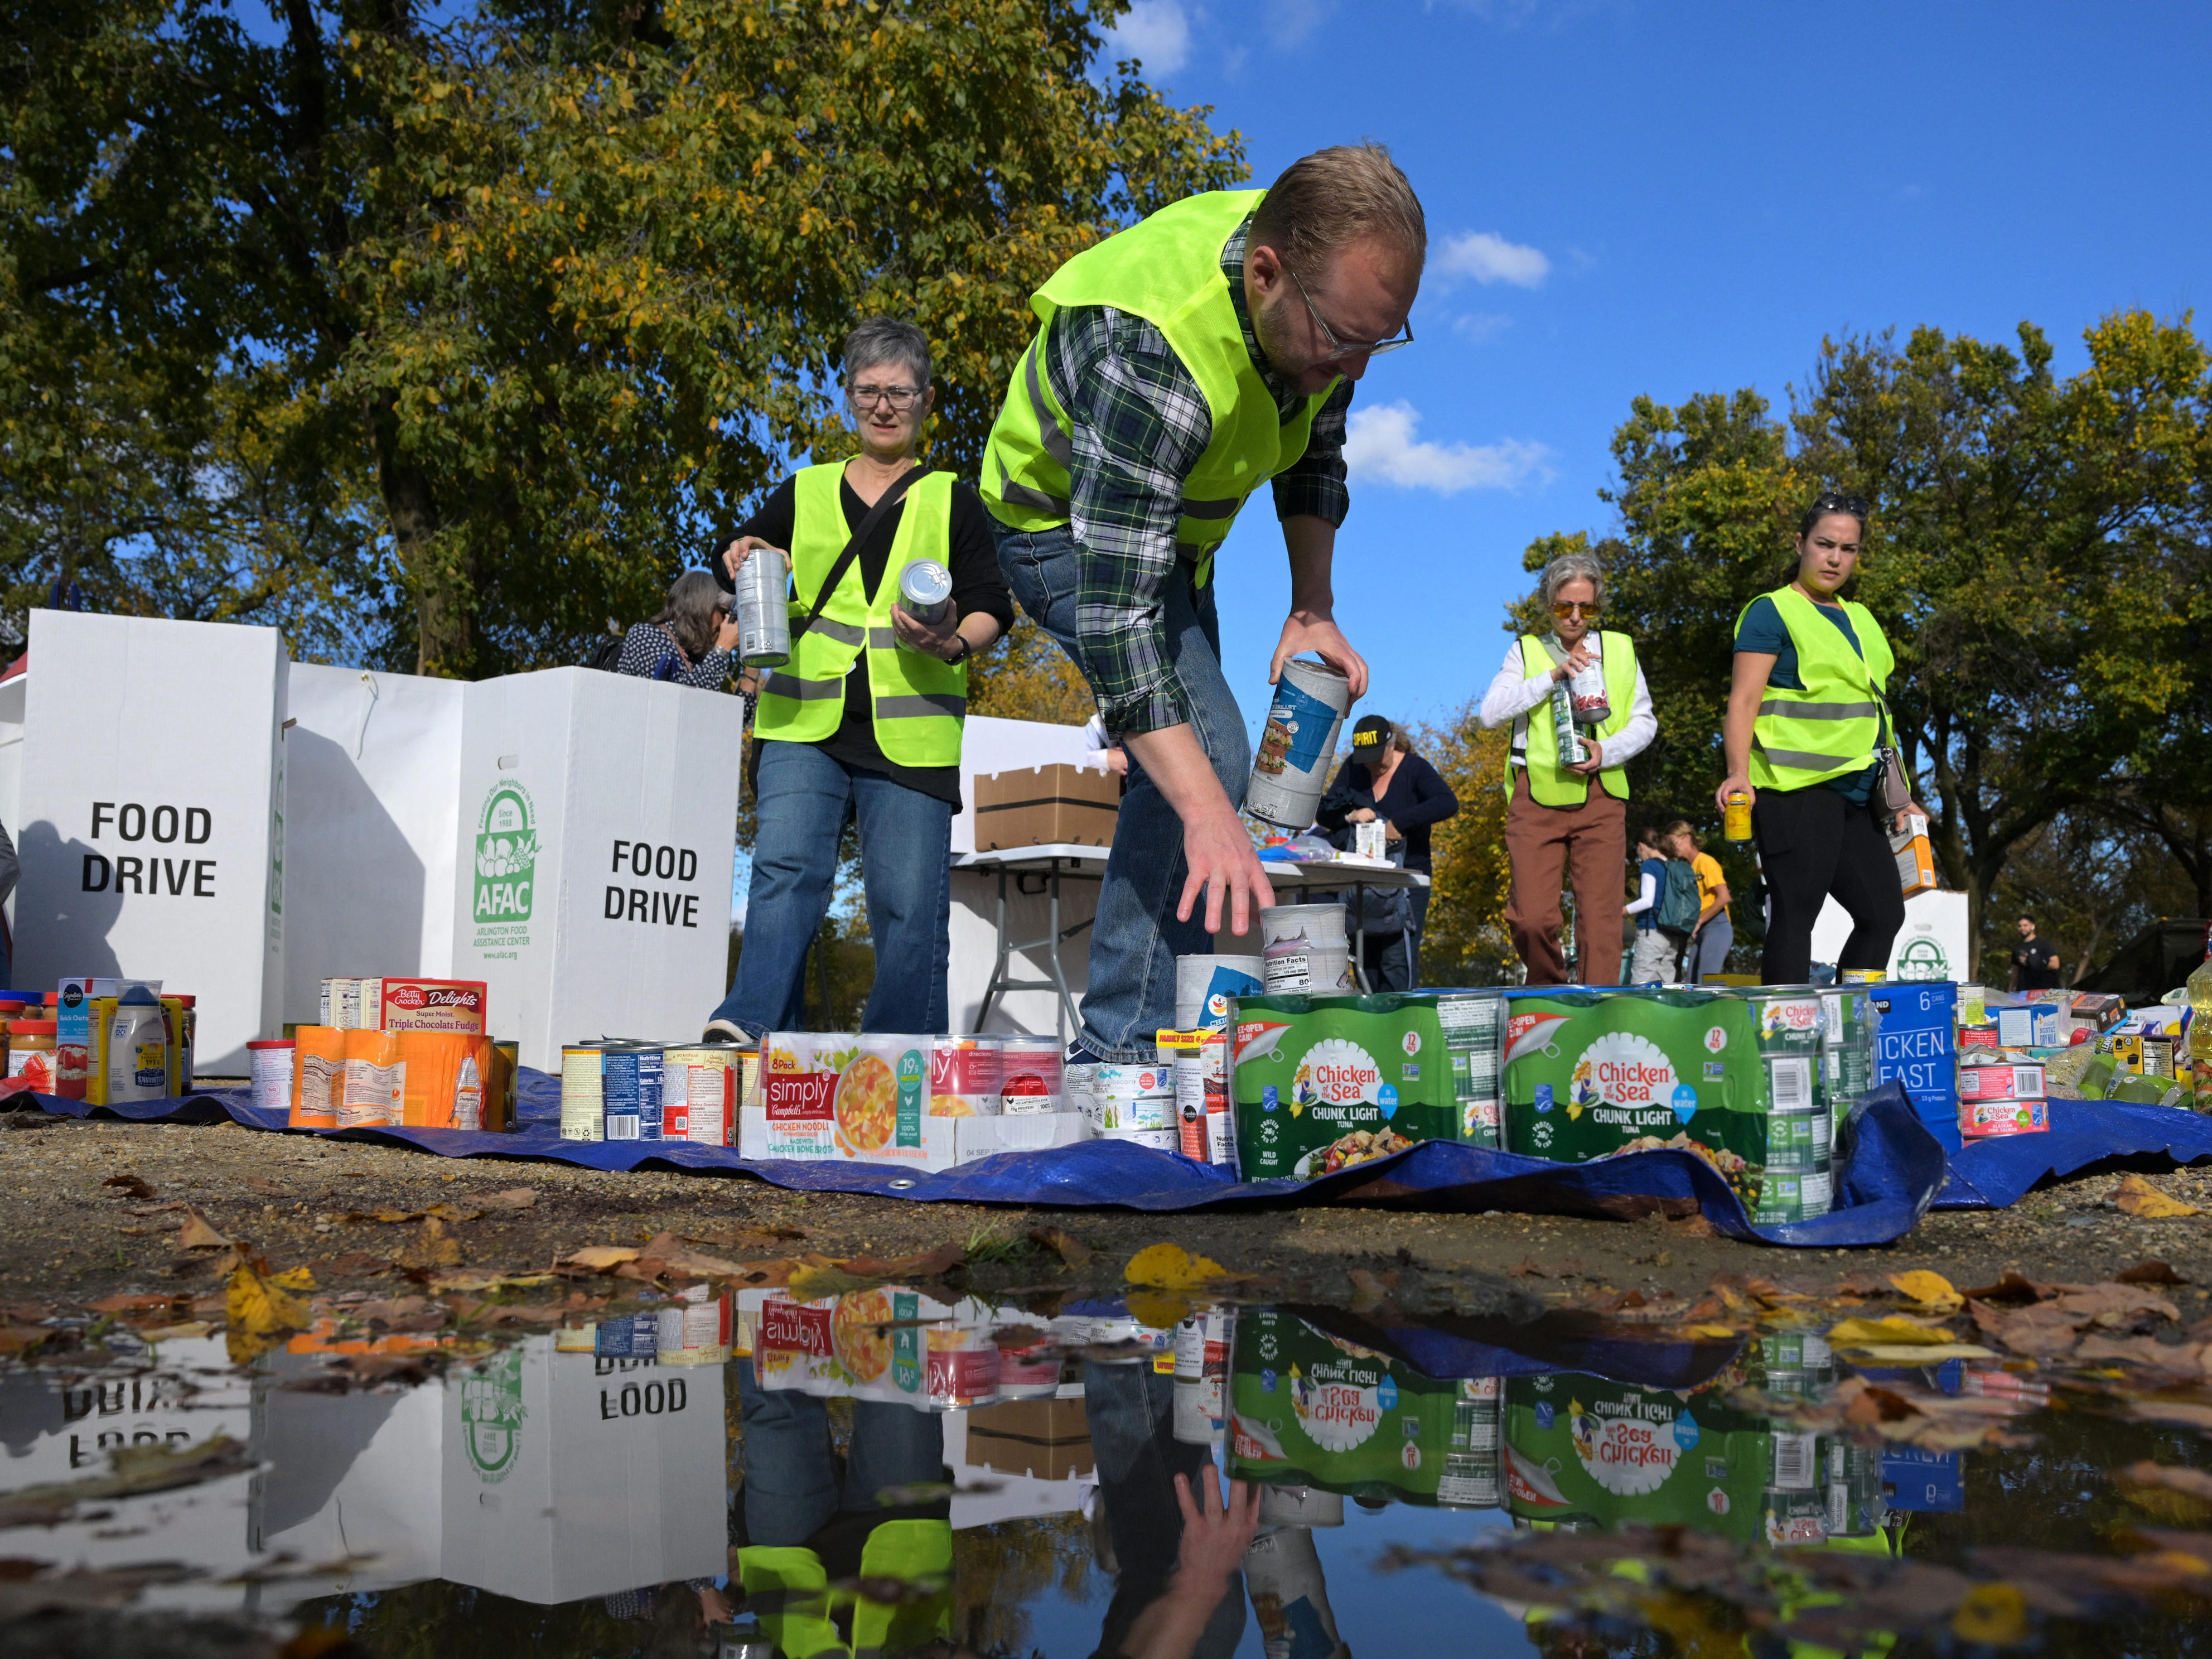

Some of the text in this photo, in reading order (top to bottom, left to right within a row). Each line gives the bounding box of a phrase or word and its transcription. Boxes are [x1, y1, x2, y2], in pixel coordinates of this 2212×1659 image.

[1353, 730, 1378, 746] SPIRIT
[478, 797, 491, 828] Feeding
[489, 784, 499, 797] Our
[499, 778, 526, 795] Neighbors
[525, 791, 530, 800] in
[499, 809, 513, 818] Since
[91, 802, 211, 845] FOOD
[612, 840, 697, 881] FOOD
[81, 855, 216, 898] DRIVE
[476, 881, 530, 916] AFAC
[605, 886, 699, 928] DRIVE
[477, 926, 527, 936] ARLINGTON FOOD
[473, 937, 530, 947] ASSISTANCE CENTER
[484, 951, 518, 960] www.afac.org
[64, 992, 83, 1002] Signature
[398, 989, 420, 999] Betty
[428, 991, 478, 1007] Delights
[394, 996, 424, 1005] Crocker
[1920, 991, 1945, 1011] 6 CANS
[389, 1019, 479, 1032] Triple Chocolate Fudge
[1508, 1015, 1535, 1028] EZ-OPEN
[1237, 1023, 1263, 1034] EZ-OPEN
[1508, 1027, 1524, 1038] CAN!
[1238, 1033, 1253, 1043] CAN!
[1408, 1034, 1416, 1045] 12
[1712, 1029, 1721, 1042] 12
[2047, 1034, 2056, 1044] MILK
[1709, 1041, 1721, 1049] PACK
[1879, 1031, 1945, 1060] ICKEN
[304, 1054, 322, 1063] Nutrition
[772, 1058, 795, 1070] 8 Pack
[903, 1058, 919, 1074] 19g
[1316, 1065, 1375, 1086] Chicken
[1598, 1062, 1669, 1084] Chicken
[1880, 1063, 1936, 1088] EAST
[770, 1076, 829, 1110] simply
[1331, 1084, 1361, 1102] Sea
[1604, 1083, 1650, 1102] the Sea
[1605, 1084, 1612, 1092] of
[1379, 1097, 1397, 1105] water
[1673, 1099, 1696, 1108] water
[771, 1104, 801, 1118] Campbell's
[1312, 1107, 1378, 1121] CHUNK LIGHT
[1593, 1108, 1672, 1125] CHUNK LIGHT
[772, 1122, 801, 1131] CHICKEN
[1260, 1118, 1279, 1130] PROTEIN
[1533, 1121, 1554, 1134] PROTEIN
[1264, 1127, 1275, 1136] 36g
[1260, 1135, 1278, 1144] PER CAN
[1533, 1138, 1553, 1148] PER CAN
[768, 1144, 795, 1154] CHICKEN
[797, 1145, 813, 1154] BONE
